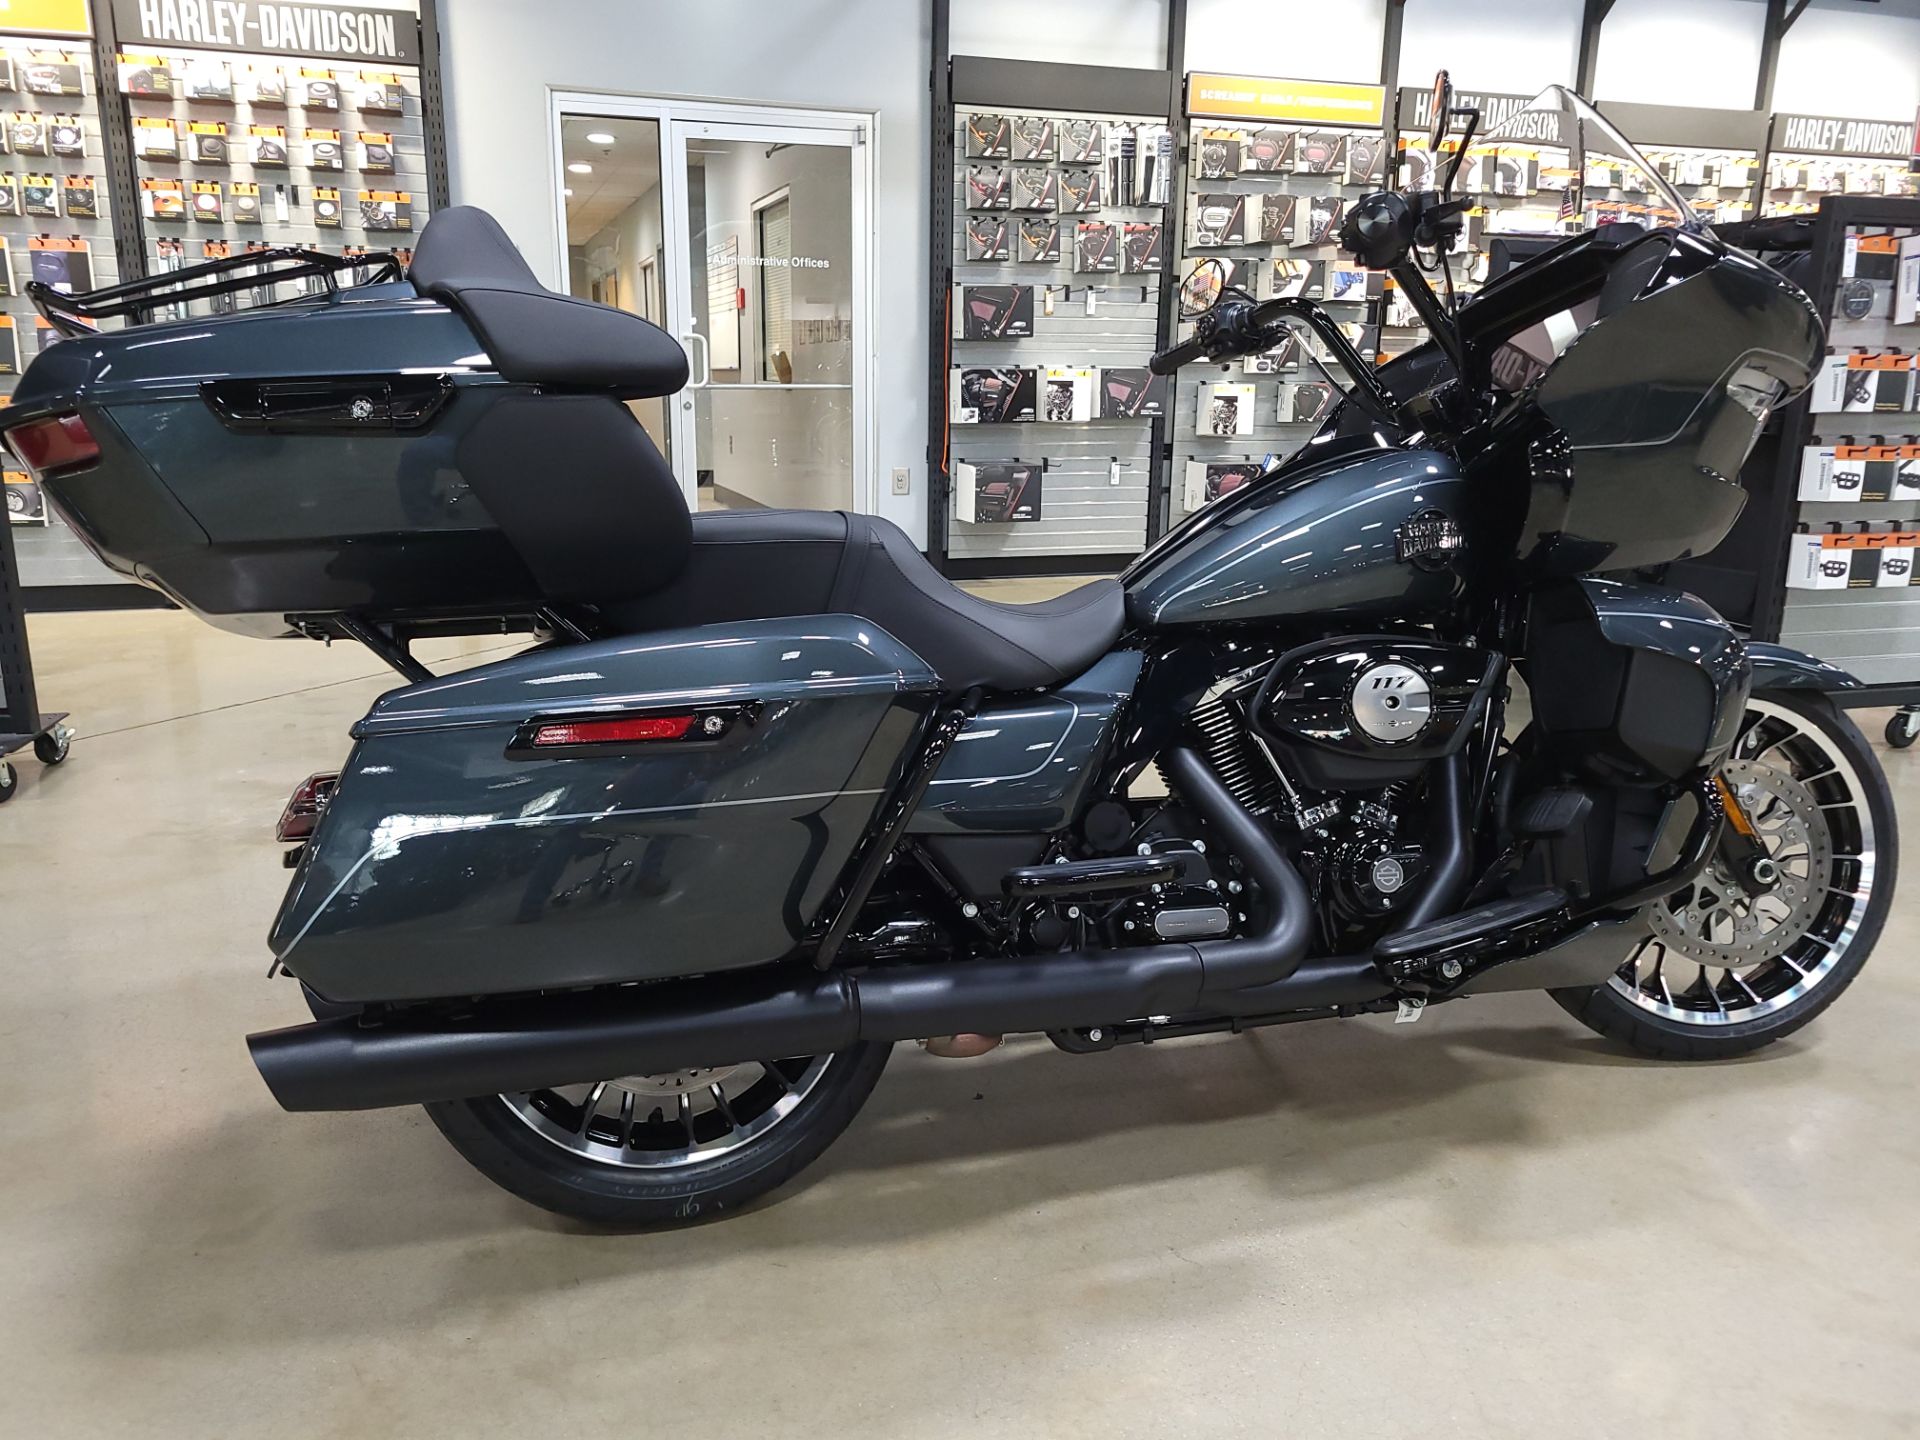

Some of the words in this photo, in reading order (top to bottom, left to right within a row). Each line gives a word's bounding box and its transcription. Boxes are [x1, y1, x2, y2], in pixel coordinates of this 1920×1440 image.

[138, 0, 396, 57] HARLEY-DAVIDSON
[1200, 89, 1256, 103] SCREA
[1414, 92, 1560, 142] HLEY-DAVIDSON
[1783, 117, 1913, 155] HARLEY-DAVIDSON
[712, 256, 789, 267] Administrative
[791, 257, 830, 268] Offices
[1371, 675, 1415, 690] 117
